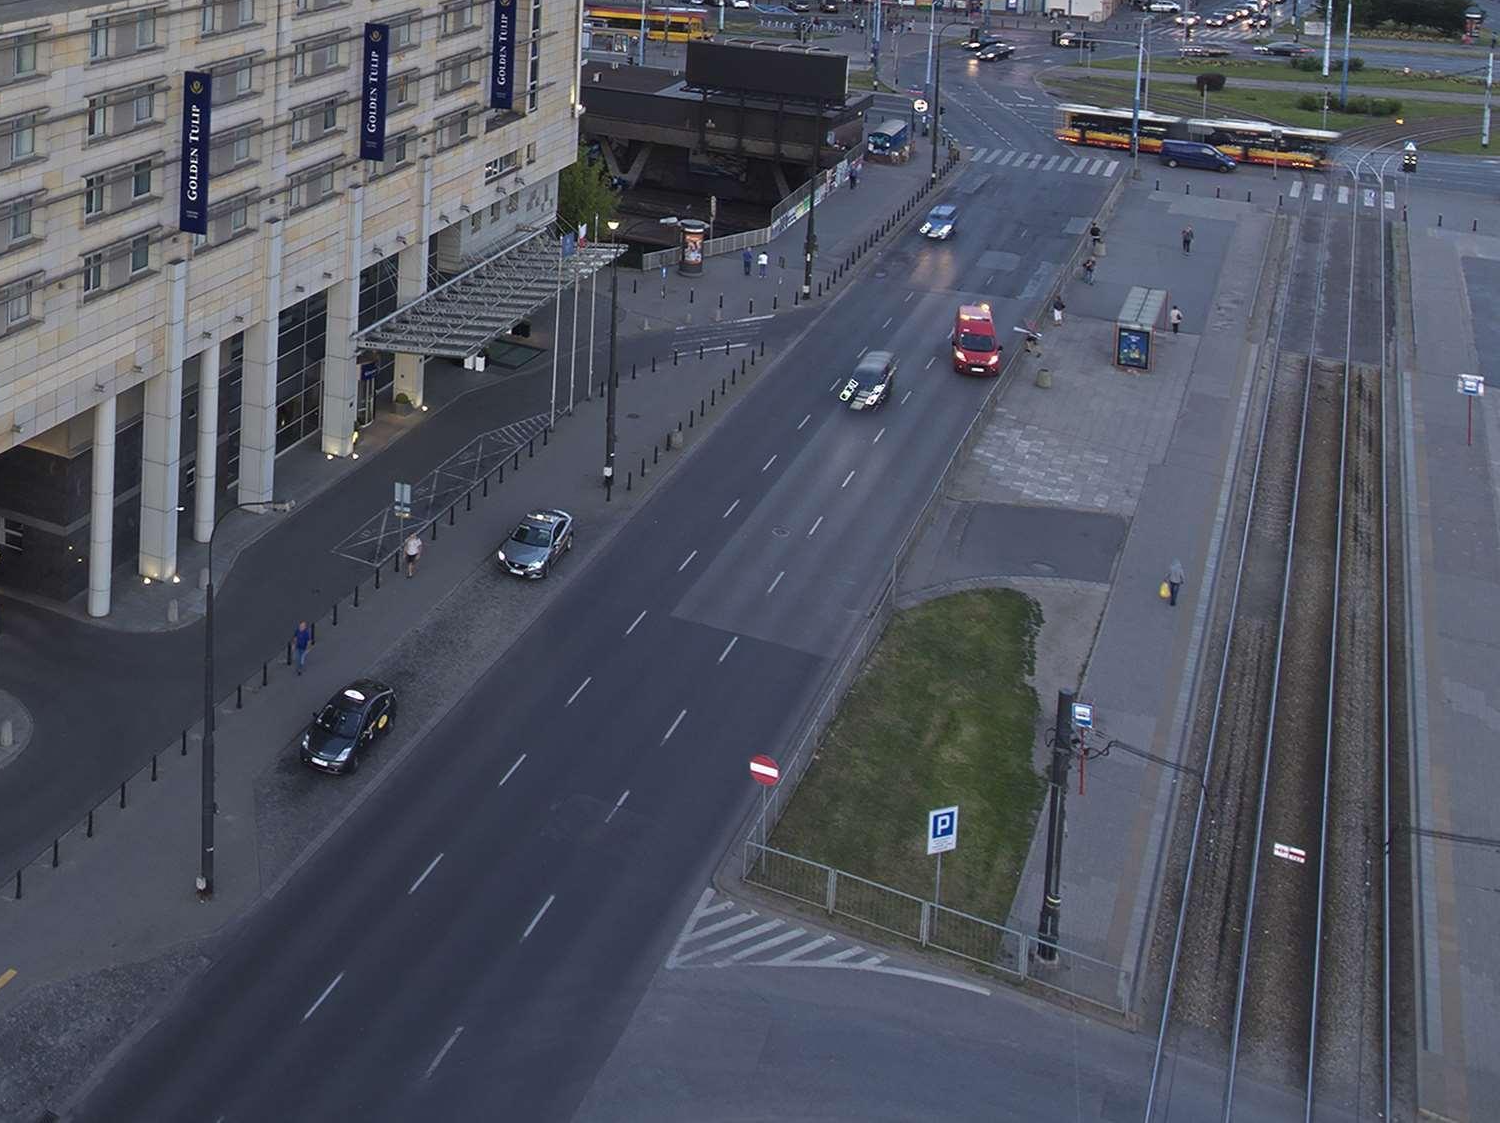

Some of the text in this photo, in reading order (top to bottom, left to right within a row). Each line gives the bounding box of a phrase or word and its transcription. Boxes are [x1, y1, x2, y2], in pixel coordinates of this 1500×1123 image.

[497, 13, 508, 86] GOLDEN TULIP
[366, 51, 379, 133] GOLDEN TULIP
[186, 104, 201, 201] GOLDEN TULIP
[937, 815, 950, 835] P
